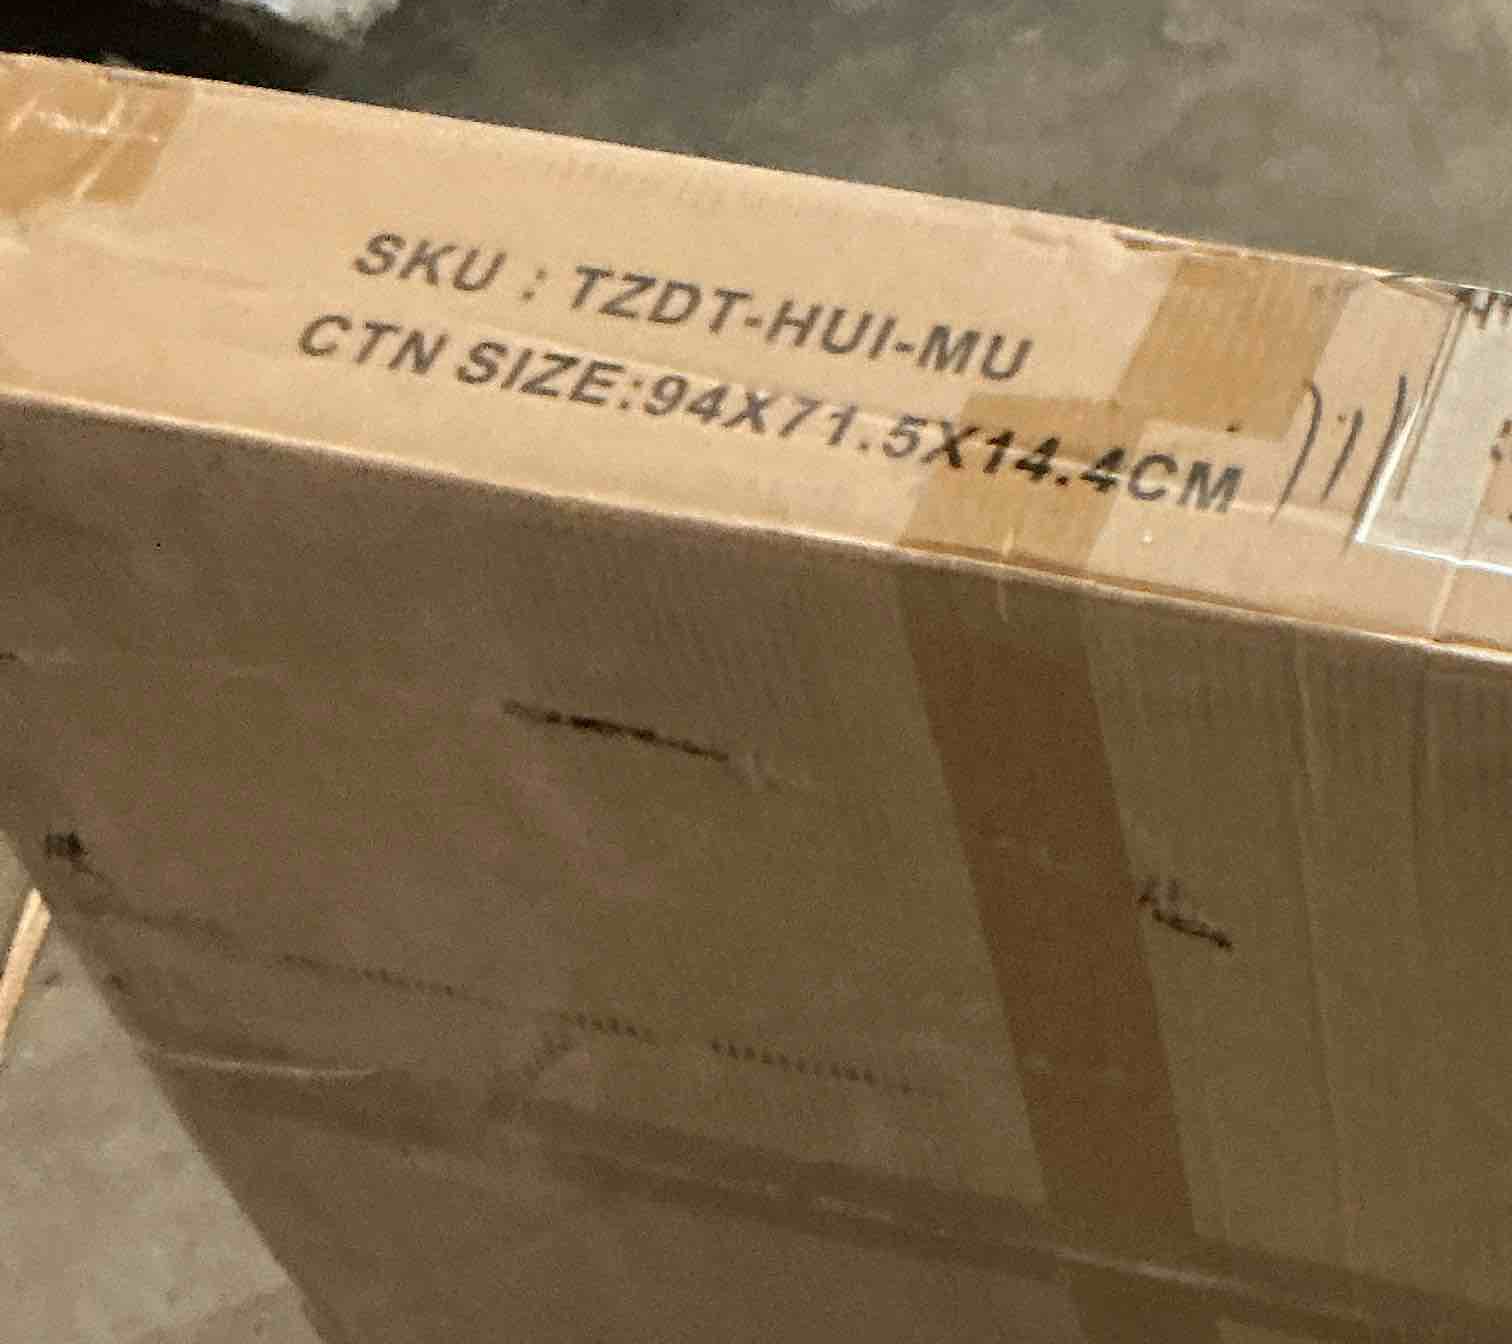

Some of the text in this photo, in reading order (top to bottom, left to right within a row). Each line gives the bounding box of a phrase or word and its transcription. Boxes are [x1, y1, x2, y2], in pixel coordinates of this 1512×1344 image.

[299, 313, 449, 375] CTN
[354, 232, 507, 292] SKU
[570, 264, 1034, 382] TZDT-HUI-MU
